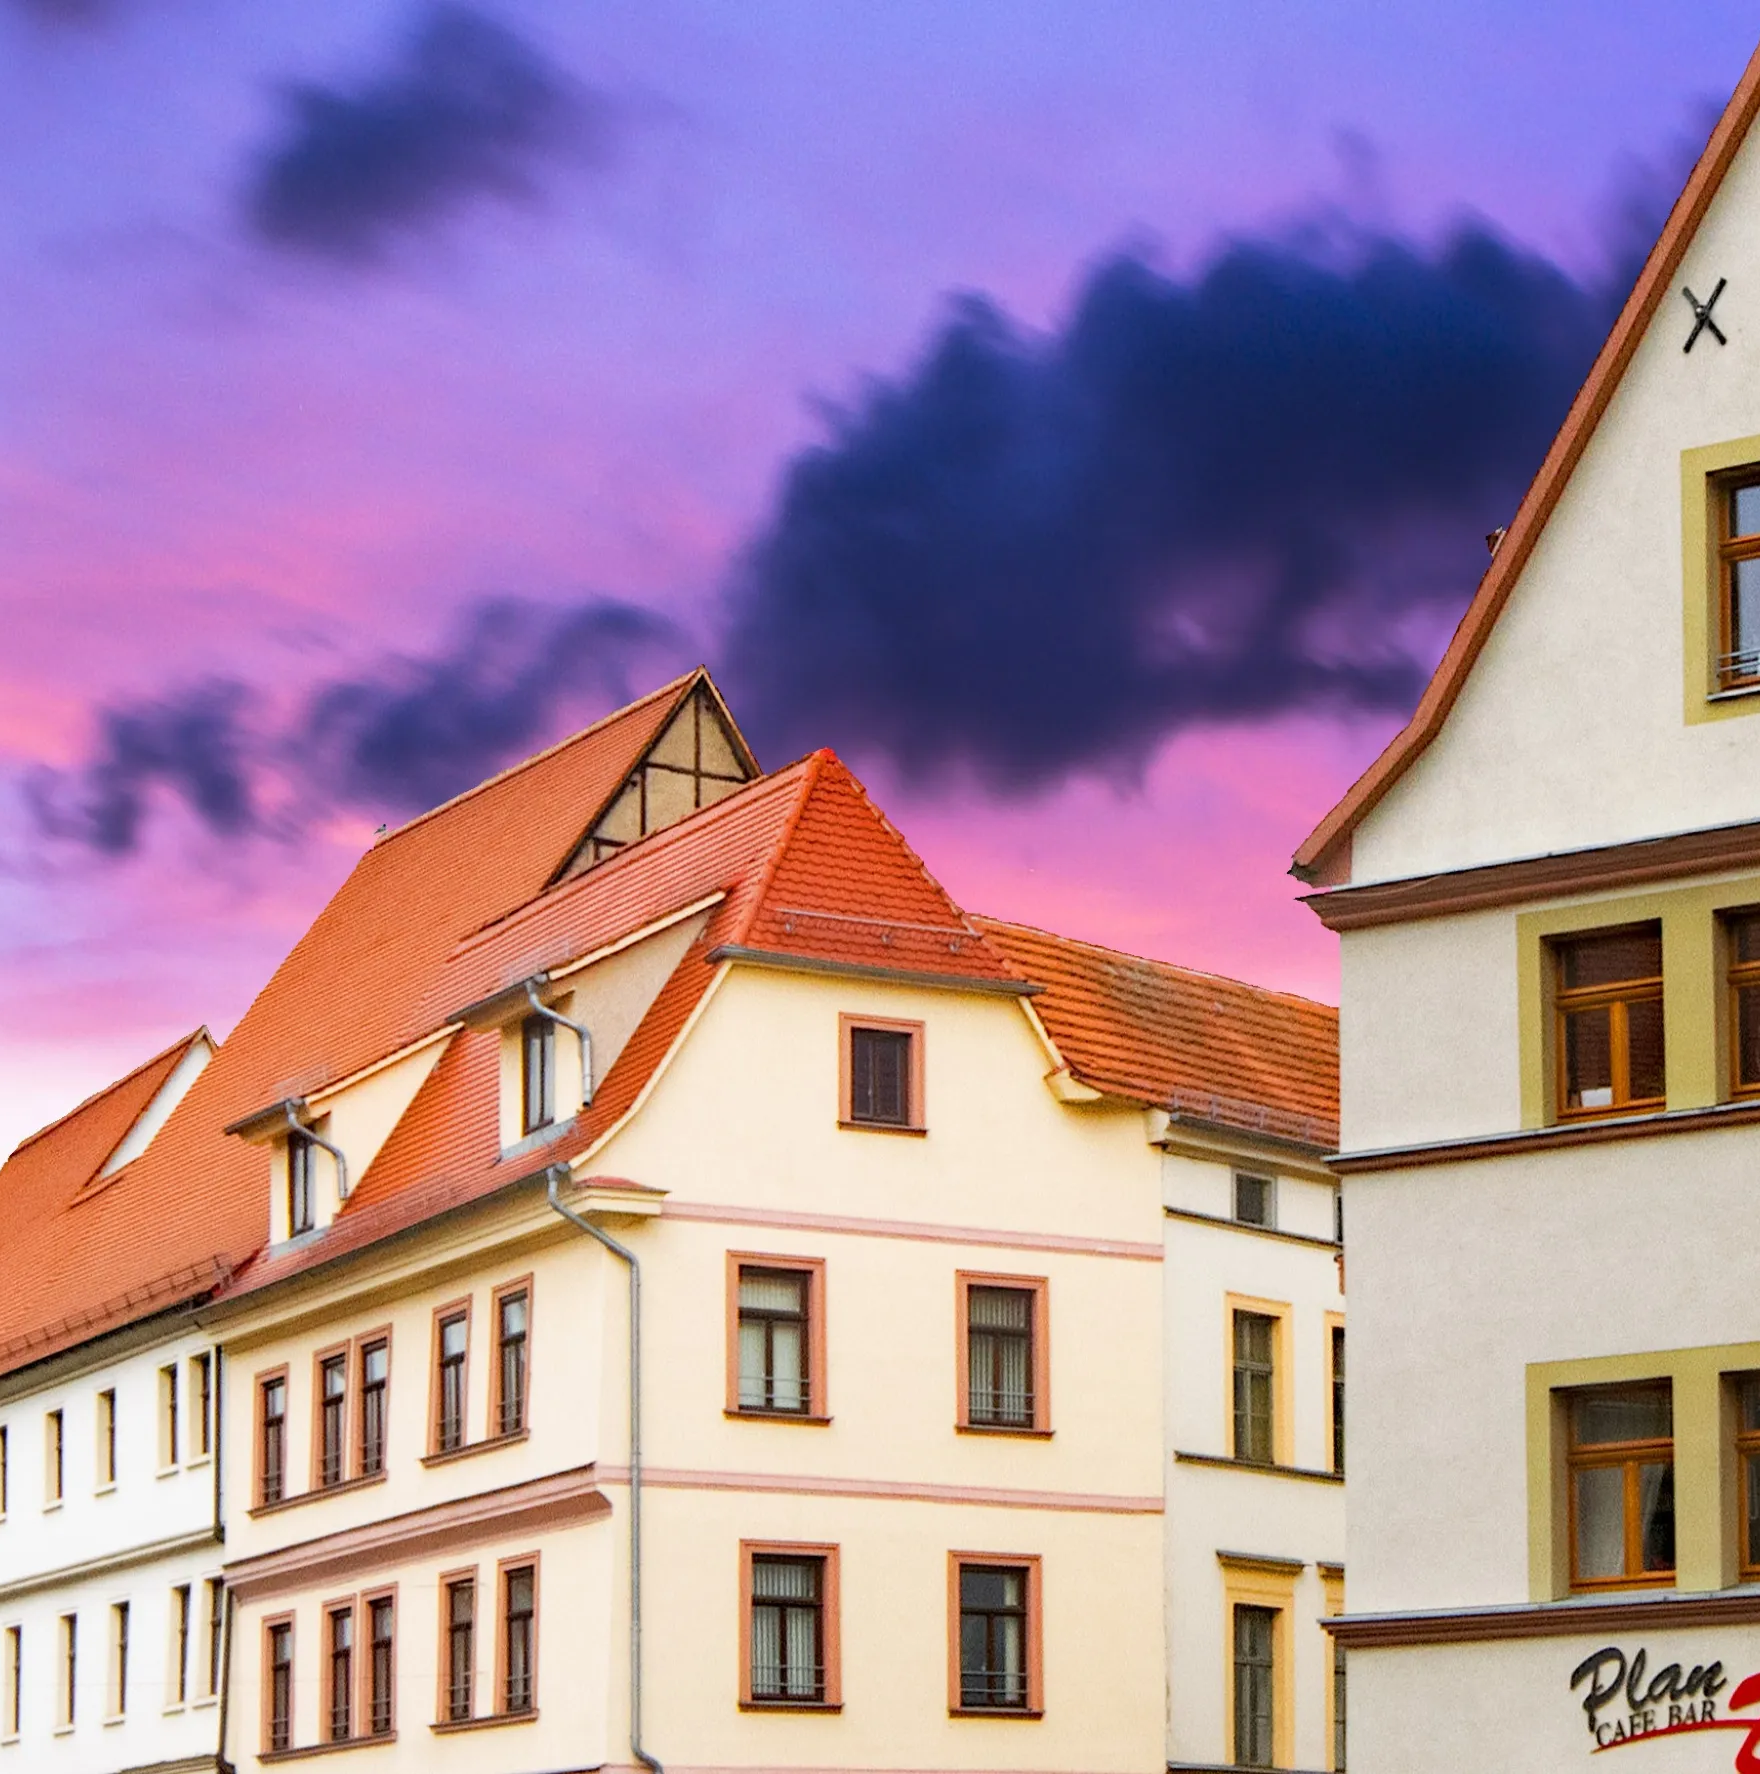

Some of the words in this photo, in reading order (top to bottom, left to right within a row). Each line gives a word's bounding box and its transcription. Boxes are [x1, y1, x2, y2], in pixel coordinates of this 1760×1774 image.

[1570, 1647, 1727, 1733] Plan
[1596, 1709, 1656, 1746] CAFE
[1668, 1700, 1716, 1727] BAR
